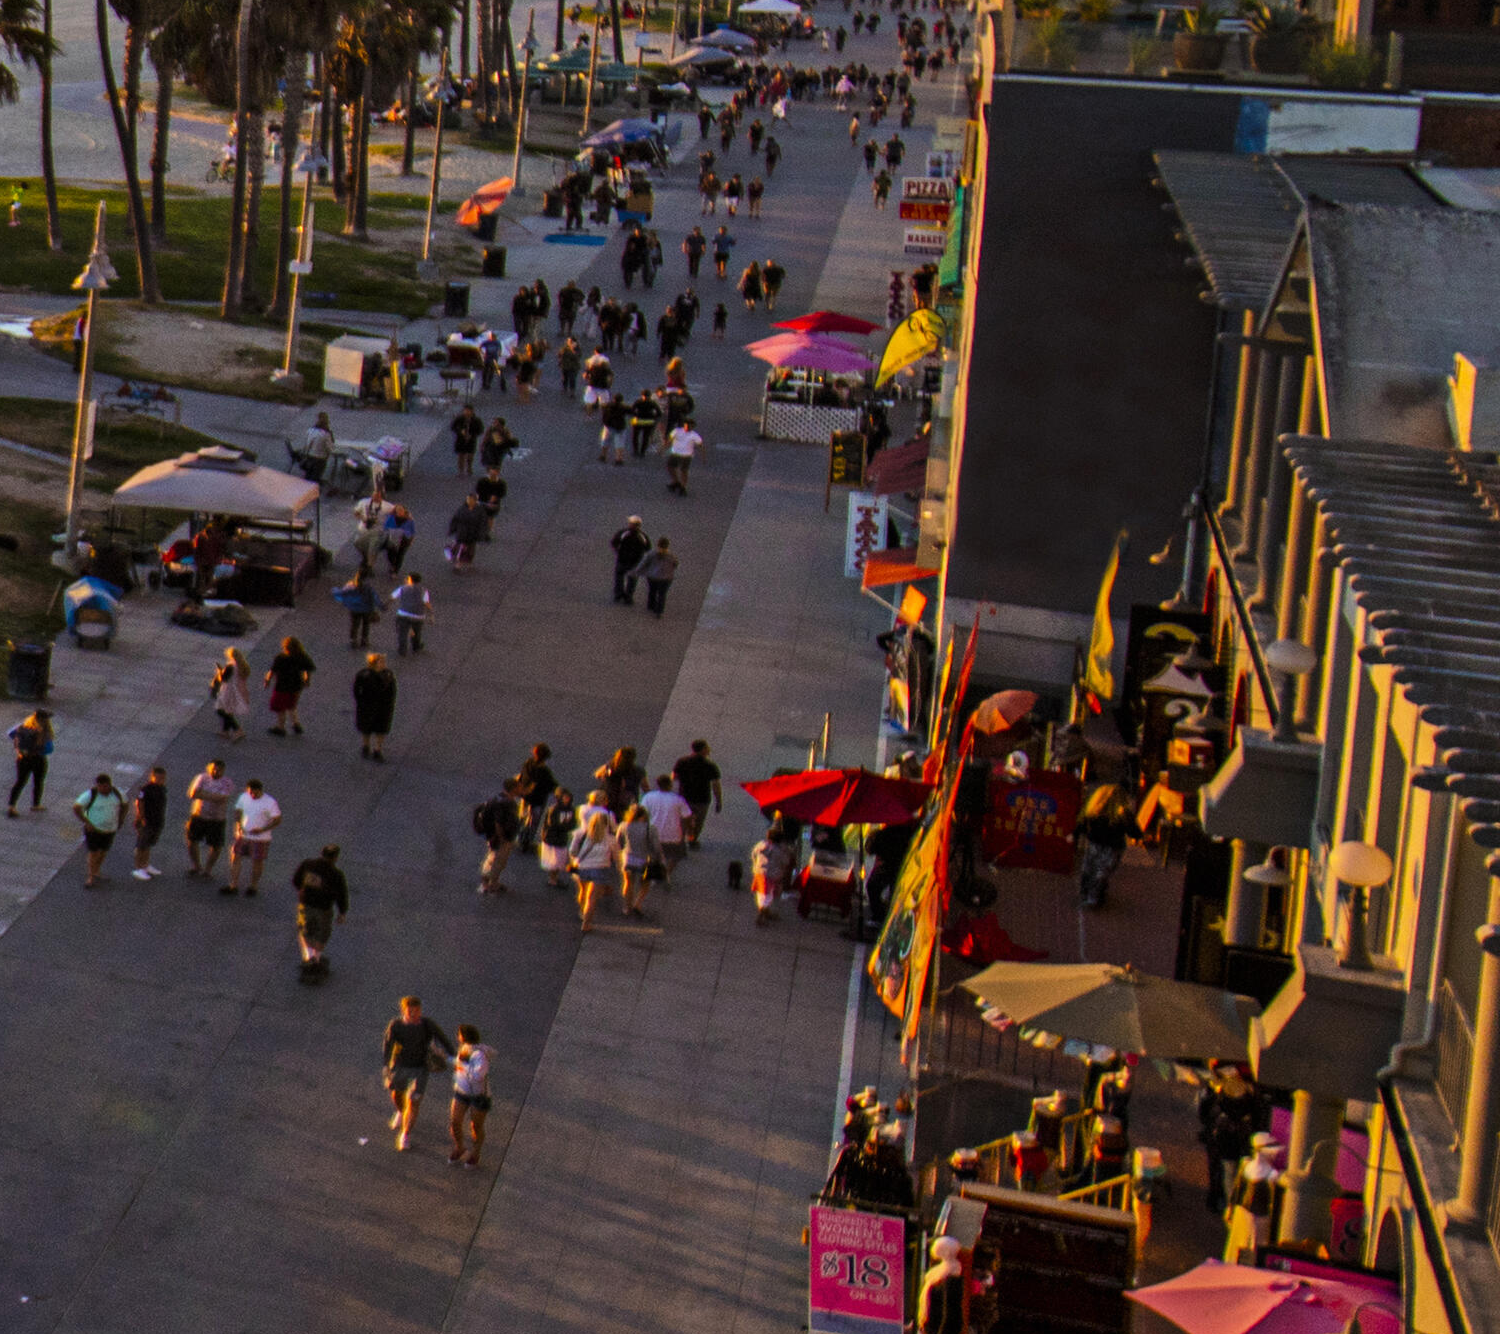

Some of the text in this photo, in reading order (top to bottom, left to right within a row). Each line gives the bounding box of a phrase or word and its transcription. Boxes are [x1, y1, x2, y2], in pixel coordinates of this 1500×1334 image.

[904, 180, 948, 196] PIZZA
[907, 234, 943, 245] MARKET
[818, 1222, 884, 1242] WOMEN'S
[821, 1250, 890, 1290] $18
